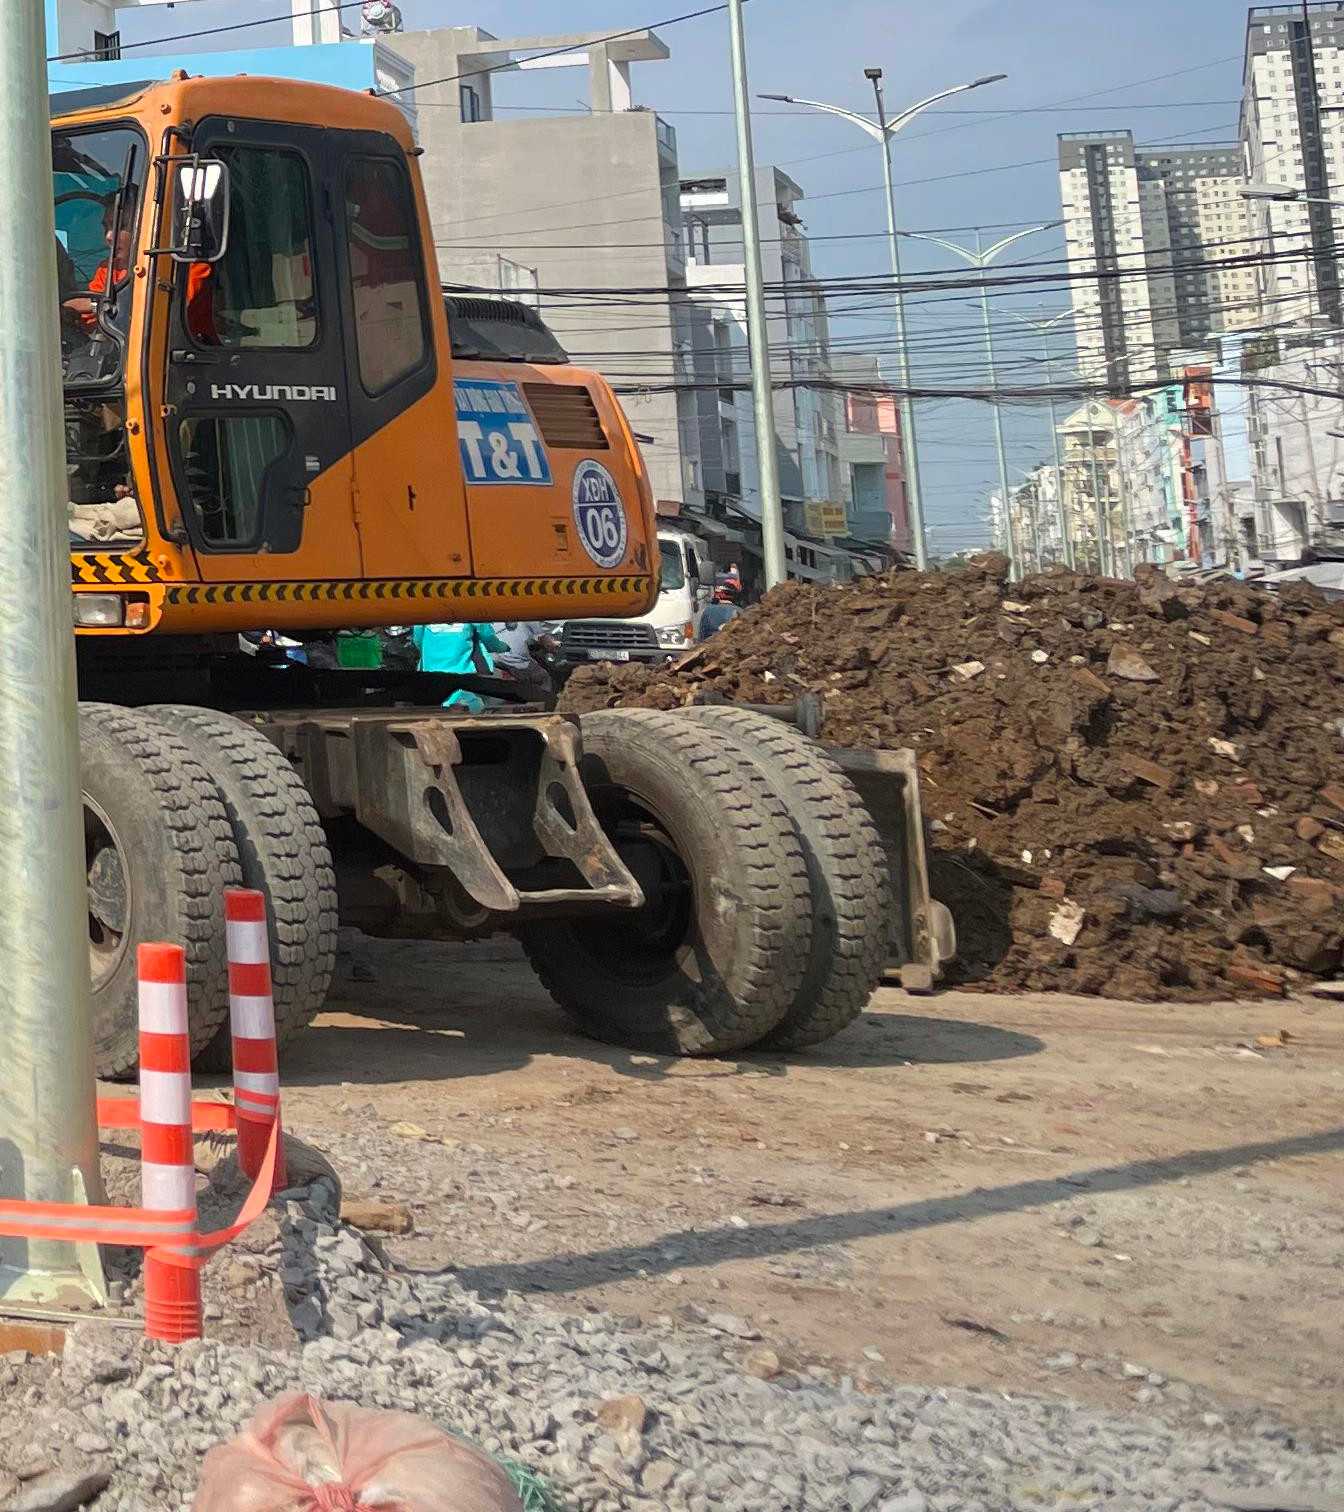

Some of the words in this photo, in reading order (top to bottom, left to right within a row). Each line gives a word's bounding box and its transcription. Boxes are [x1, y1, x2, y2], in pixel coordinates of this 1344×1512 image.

[210, 384, 337, 401] HYUNDAI
[456, 420, 543, 479] T&T
[586, 508, 619, 549] 06
